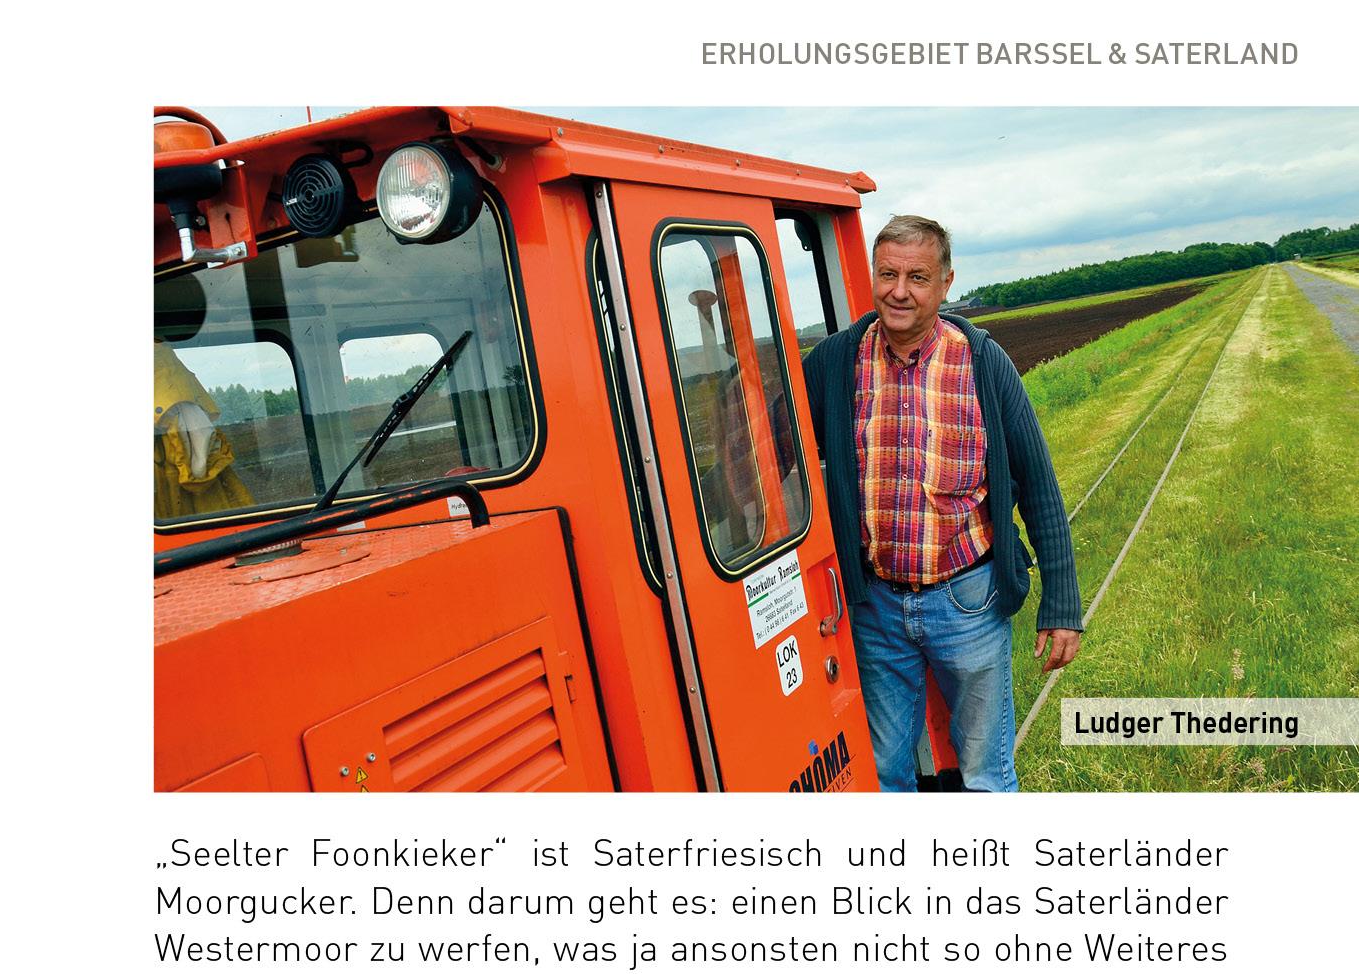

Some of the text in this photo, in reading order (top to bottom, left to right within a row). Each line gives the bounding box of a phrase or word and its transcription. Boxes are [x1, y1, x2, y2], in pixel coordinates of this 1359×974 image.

[703, 43, 1297, 64] ERHOLUNGSGEBIET BARSSEL & SATERLAND
[777, 640, 798, 668] LOK
[786, 668, 798, 688] 23
[157, 837, 1228, 869] „Seelter Foonkieker“ ist Saterfriesisch und heißt Saterländer
[158, 887, 1228, 923] Moorgucker. Denn darum geht es: einen Blick in das Saterländer
